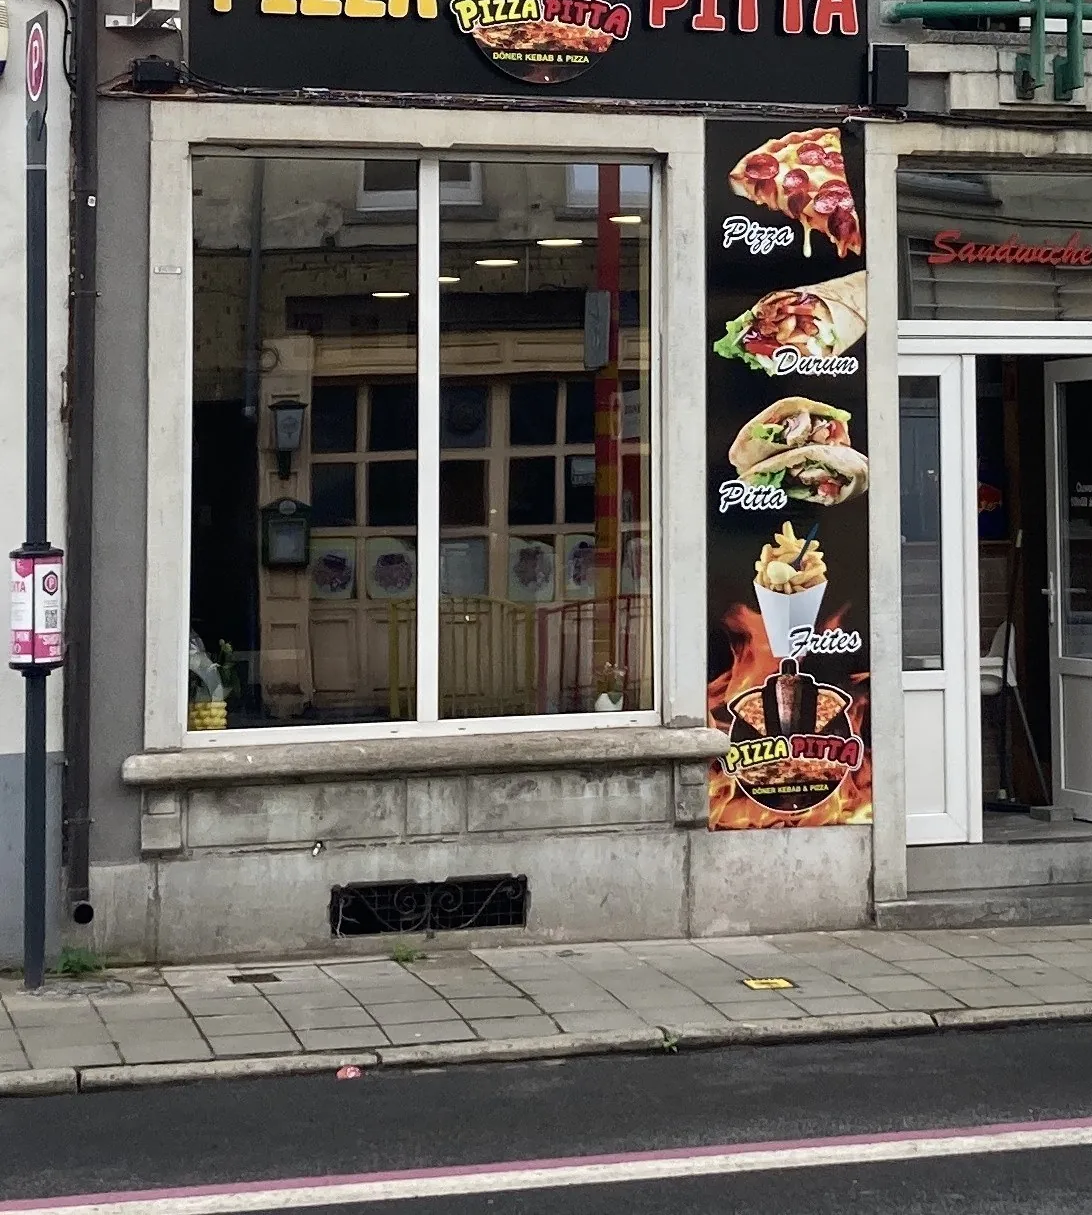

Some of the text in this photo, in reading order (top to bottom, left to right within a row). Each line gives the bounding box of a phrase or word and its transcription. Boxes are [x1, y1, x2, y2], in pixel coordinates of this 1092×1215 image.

[525, 53, 554, 63] KEBAB
[566, 55, 589, 64] PIZZA
[723, 216, 794, 255] Pizza
[774, 344, 858, 376] Durum
[720, 481, 788, 512] Pitta
[790, 625, 861, 658] Frites
[725, 736, 859, 773] PIZZA PITTA
[778, 785, 801, 793] KEBAB
